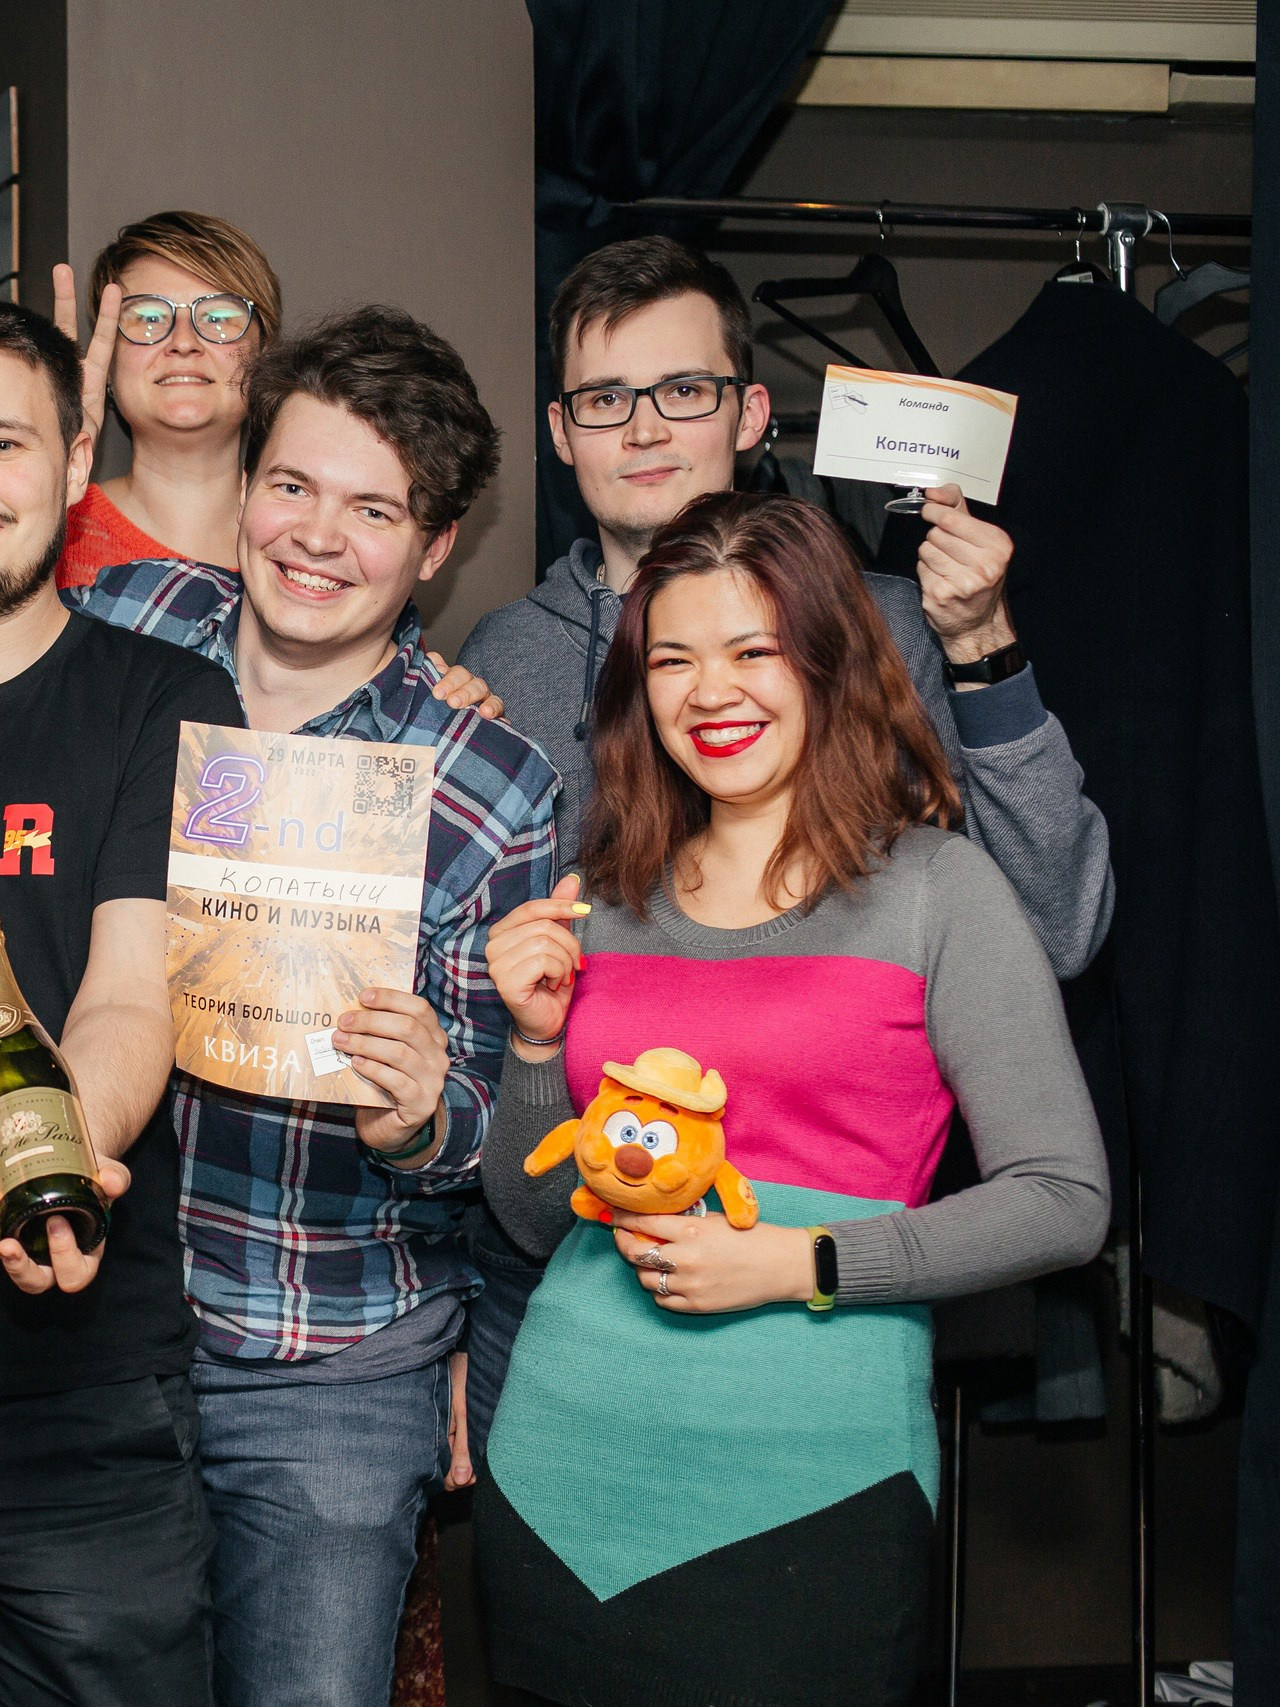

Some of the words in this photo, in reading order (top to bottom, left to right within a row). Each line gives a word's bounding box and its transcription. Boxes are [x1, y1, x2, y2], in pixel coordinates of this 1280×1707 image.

[898, 397, 950, 412] Команда
[875, 435, 961, 460] Копатычи
[267, 747, 285, 762] 29
[291, 750, 345, 768] МАРТА
[293, 767, 316, 777] 2022
[200, 896, 259, 923] КИНО
[267, 905, 282, 926] И
[290, 907, 382, 935] МУЗЫКА
[182, 992, 237, 1017] ТЕОРИЯ
[242, 1004, 332, 1028] БОЛЬШОГО
[203, 1035, 303, 1074] КВИЗА
[36, 1121, 83, 1145] Paris
